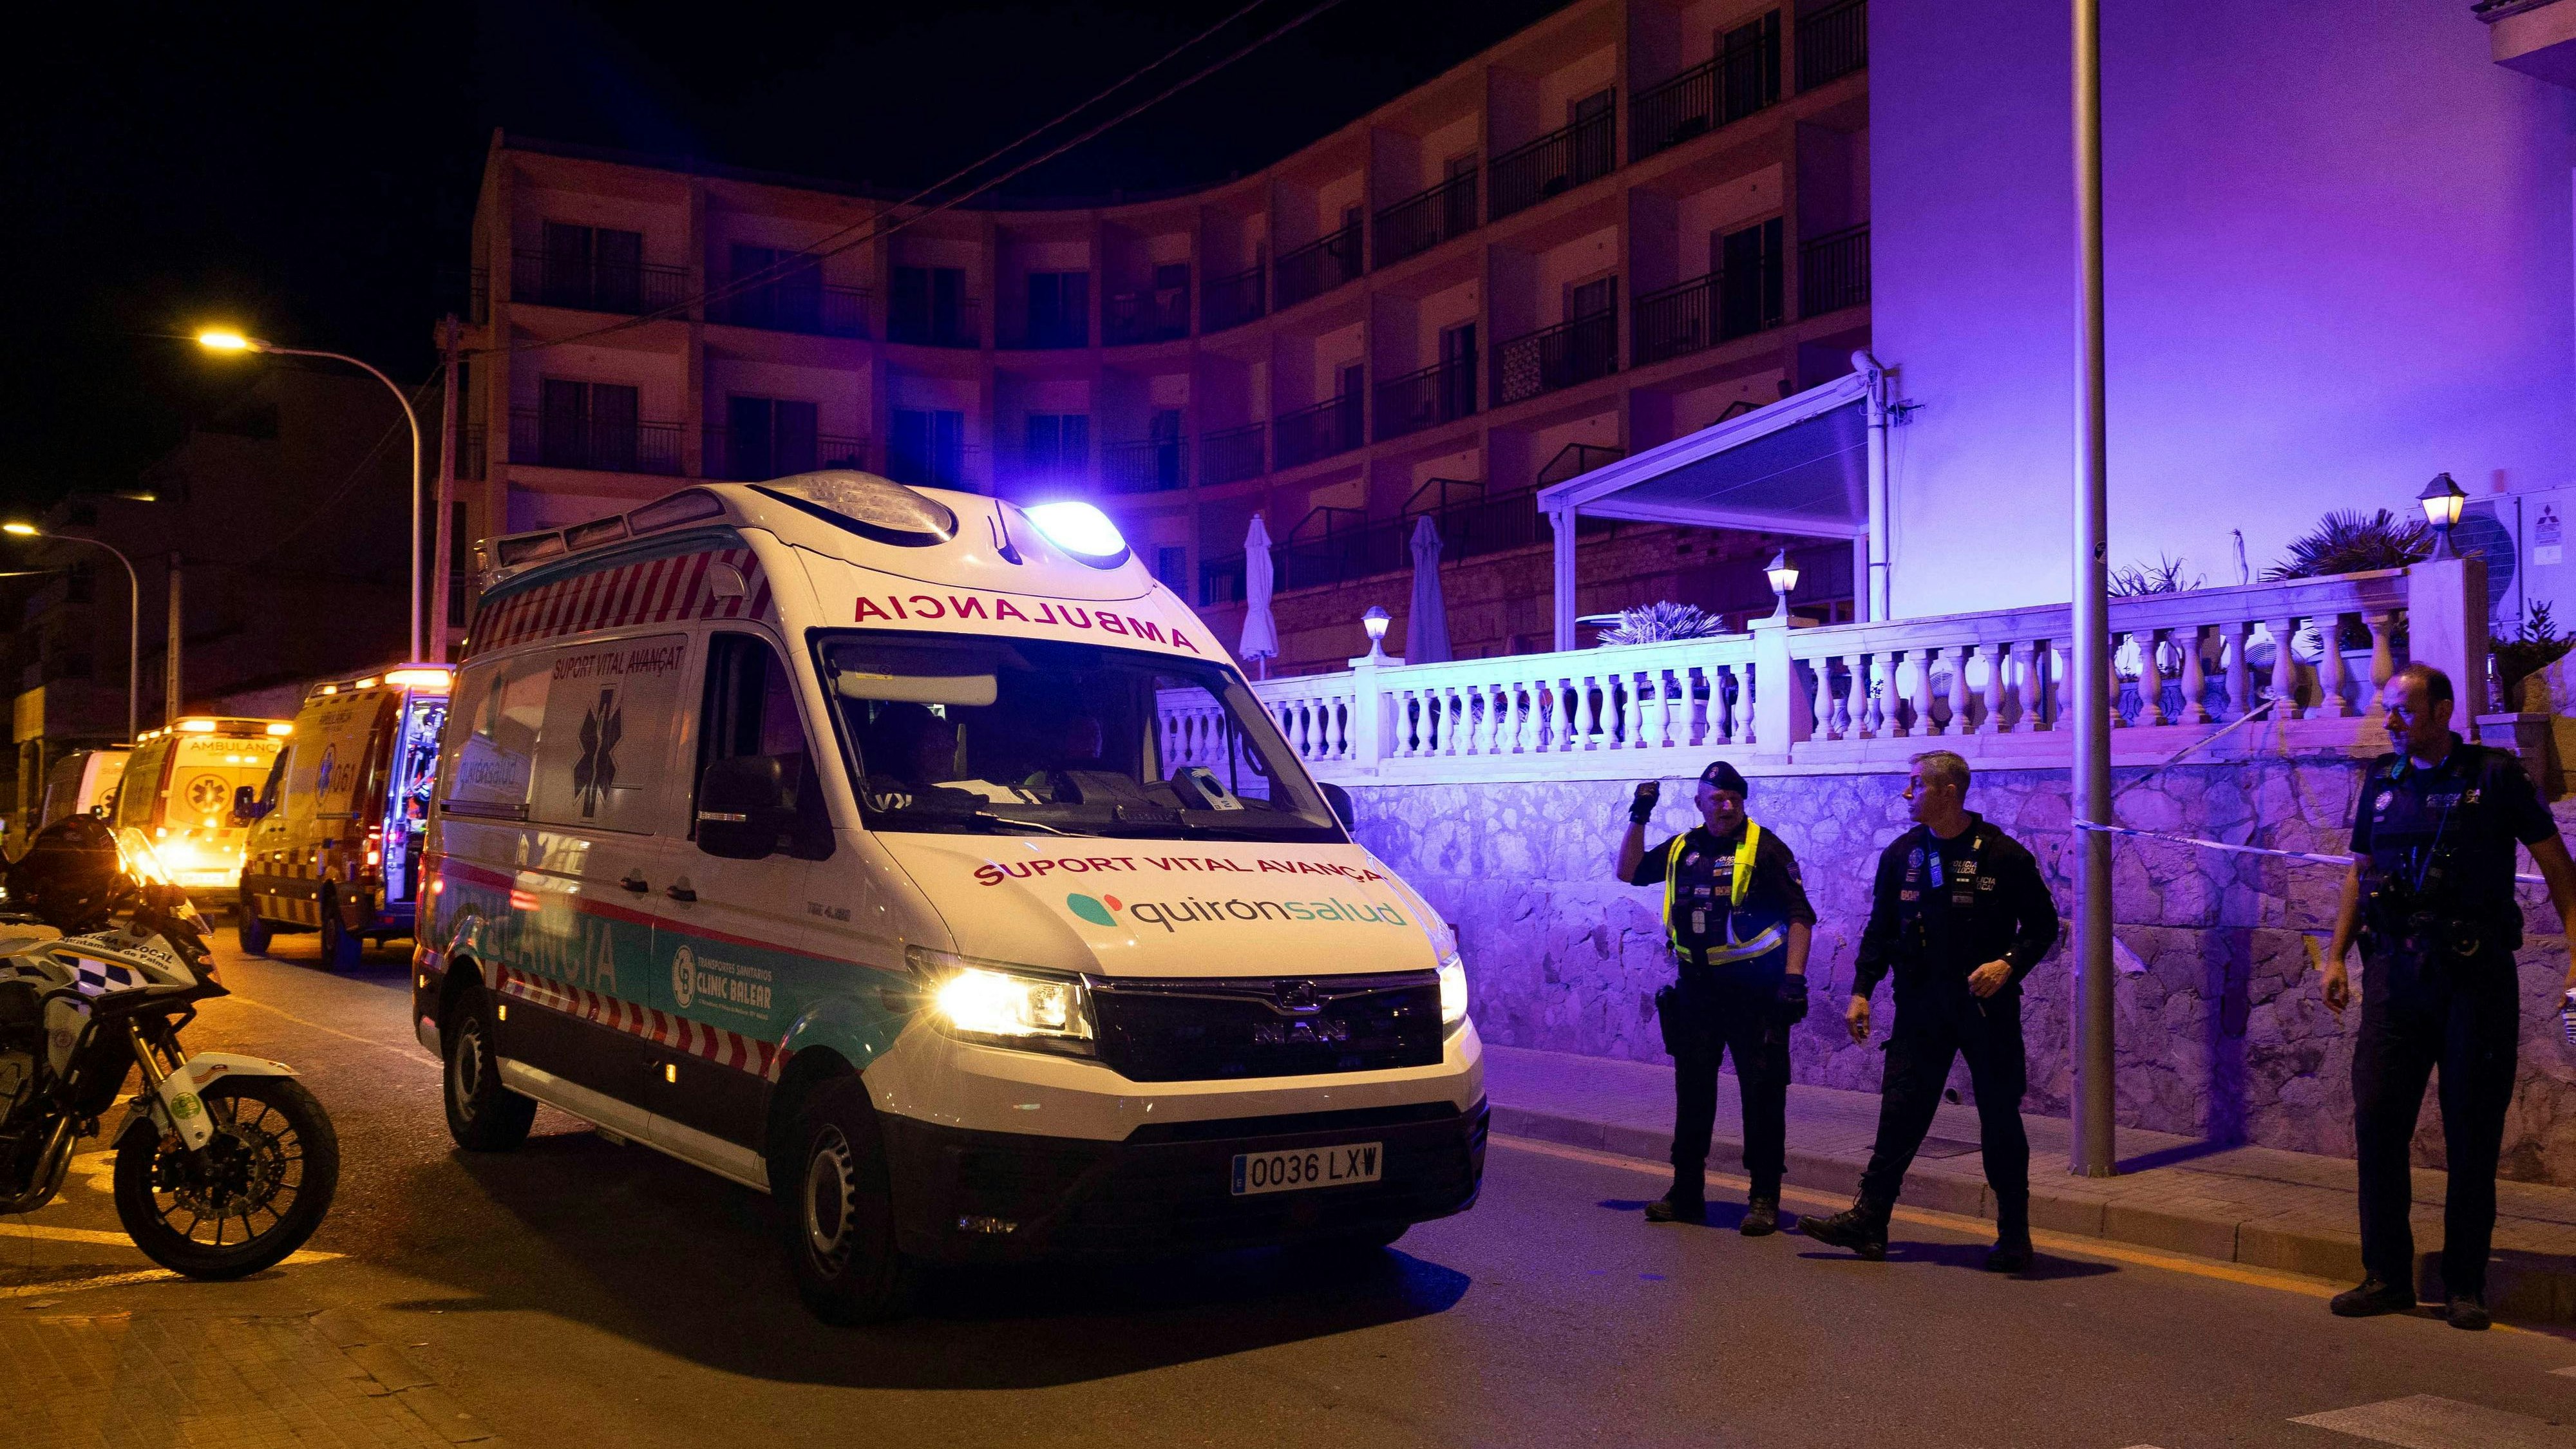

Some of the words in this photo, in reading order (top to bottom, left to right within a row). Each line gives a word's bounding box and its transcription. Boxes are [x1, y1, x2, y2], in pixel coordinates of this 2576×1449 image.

[553, 655, 596, 680] SUPORT
[596, 652, 624, 676] VITAL
[626, 645, 685, 677] AVANÇAT
[973, 857, 1137, 886] SUPORT
[1146, 857, 1255, 871] VITAL
[1976, 876, 1996, 885] LICIA
[1130, 896, 1408, 933] quirónsalud
[131, 943, 173, 963] LOCAL
[140, 953, 170, 971] Palma
[698, 956, 735, 974] TRANSPORTES
[736, 965, 772, 982] SANITARIOS
[697, 972, 728, 999] CLINIC
[730, 979, 772, 1009] BALEAR
[1251, 1153, 1320, 1188] 0036
[1329, 1148, 1377, 1180] LXW
